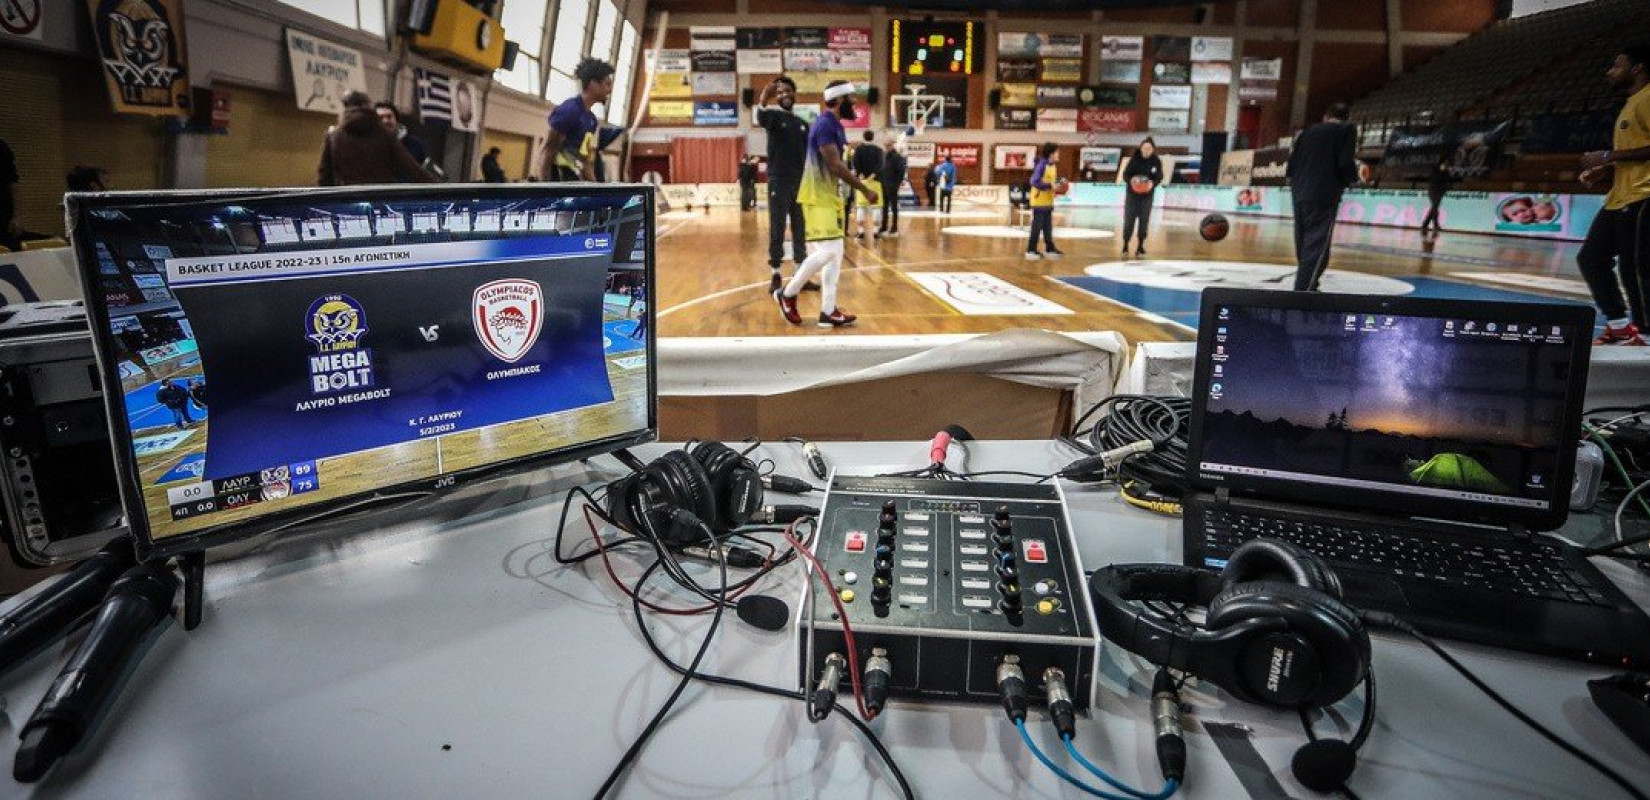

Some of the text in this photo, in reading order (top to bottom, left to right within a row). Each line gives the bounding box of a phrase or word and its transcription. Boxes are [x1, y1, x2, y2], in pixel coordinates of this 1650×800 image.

[178, 264, 224, 275] BASKET
[228, 259, 272, 272] LEAGUE
[275, 256, 322, 269] 2022-23
[353, 250, 411, 263] ΑΓΩΝΙΣΤΙΚΗ
[479, 284, 535, 302] OLYMPIACOS
[488, 294, 528, 305] BASKETBALL
[419, 325, 440, 343] VS
[310, 350, 370, 373] MEGA
[312, 368, 371, 393] BOLT
[486, 364, 541, 381] ΟΛΥΜΠΙΑΚΟΣ
[295, 388, 391, 412] ΛΑΥΡΙΟ MEGABOLT
[428, 410, 463, 424] ΛΑΥΡΙΟΥ
[419, 423, 456, 436] 5/2/2023
[183, 465, 311, 498] 0.0 ΛΑΥΡ 89
[434, 476, 455, 489] JVC
[197, 502, 215, 512] 0.0
[227, 492, 249, 506] ΟΛΥ
[298, 480, 312, 491] 75
[1267, 647, 1284, 692] SHURE
